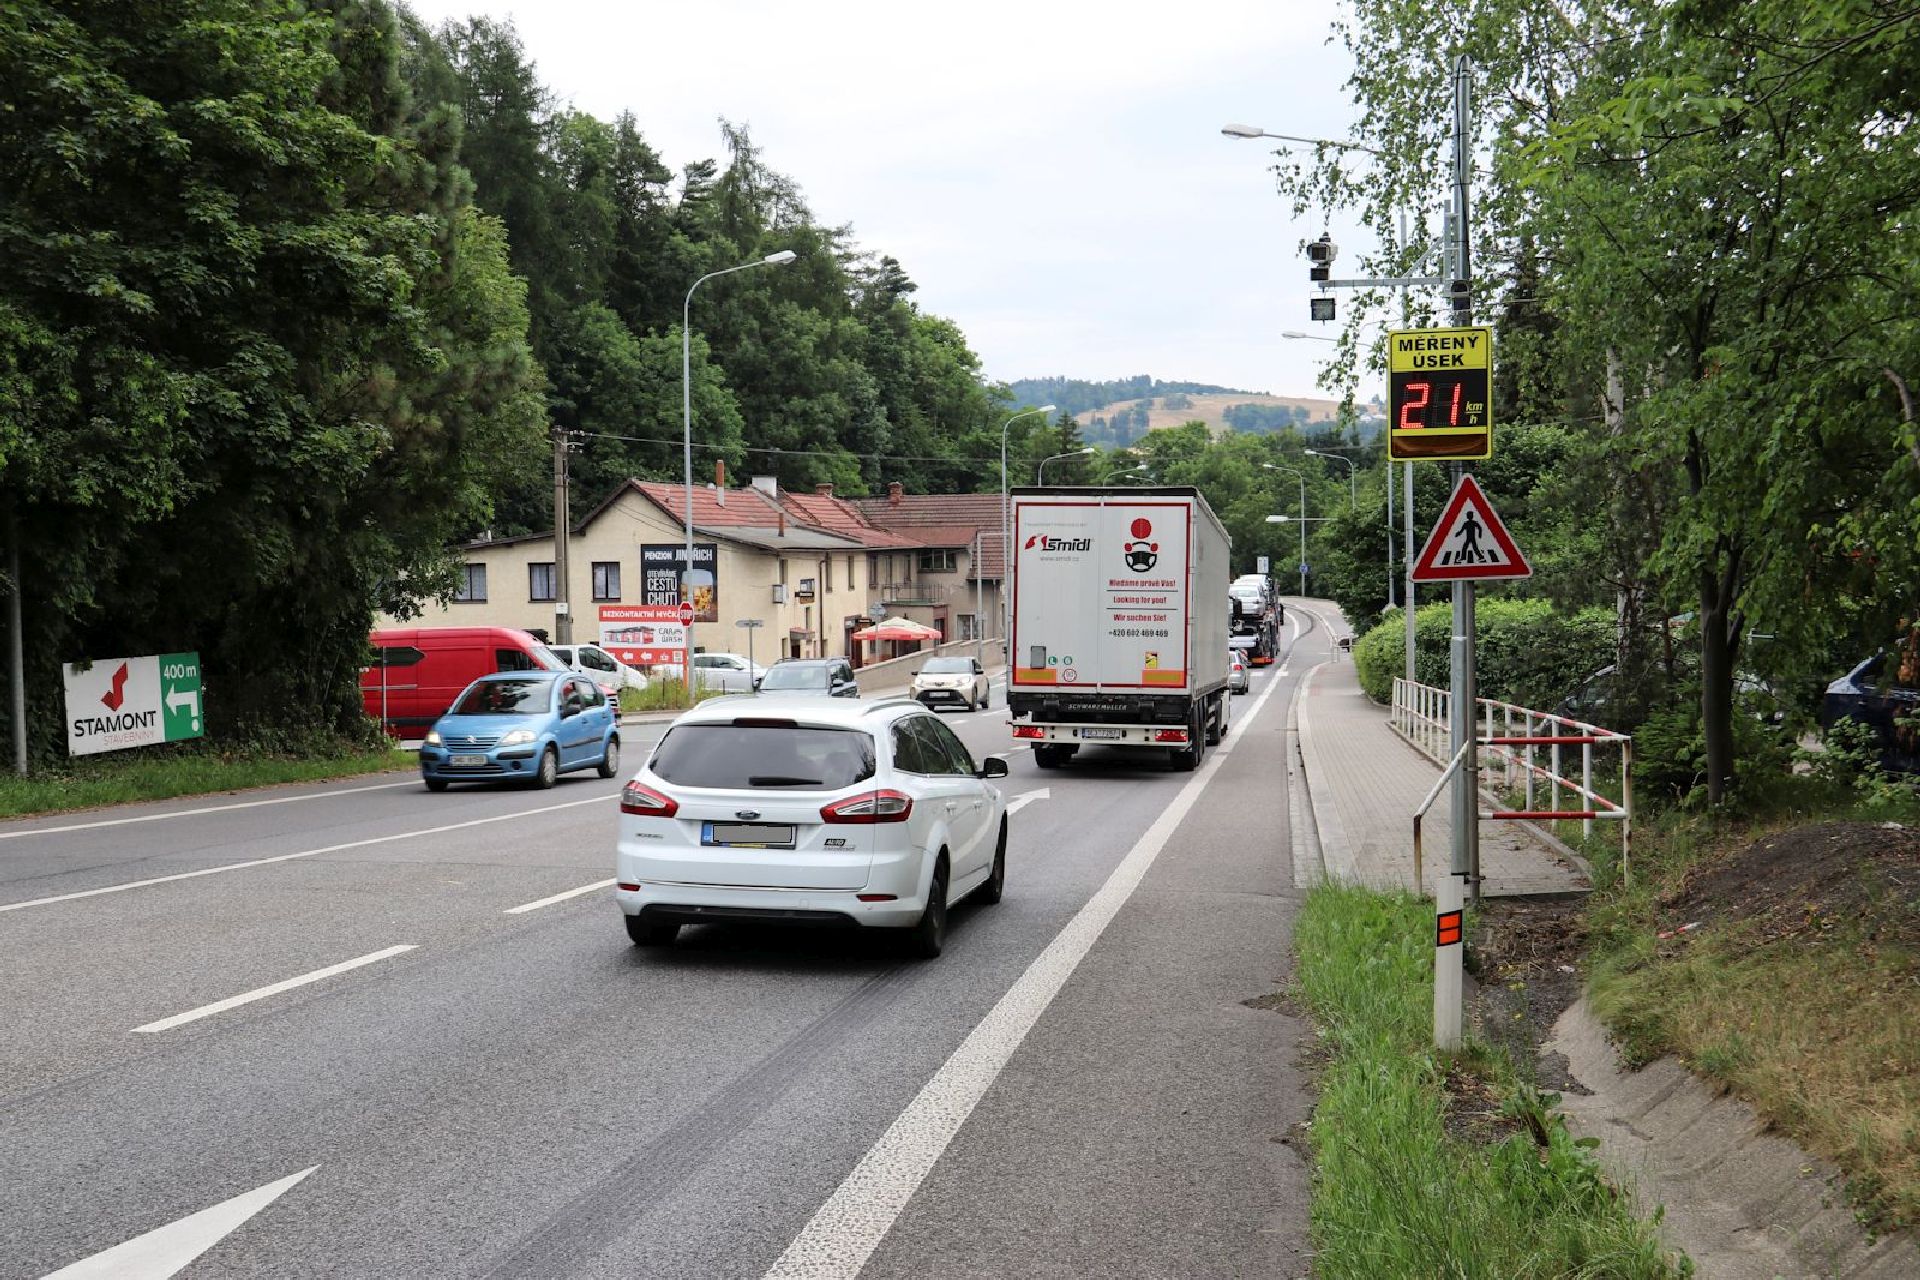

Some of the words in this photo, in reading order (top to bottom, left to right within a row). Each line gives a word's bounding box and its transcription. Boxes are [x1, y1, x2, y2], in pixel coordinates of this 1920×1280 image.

[1399, 333, 1479, 351] MĚŘENÝ
[1413, 352, 1464, 368] ÚSEK
[1400, 382, 1461, 429] 21
[1465, 401, 1483, 411] km
[1469, 415, 1477, 424] h
[675, 547, 713, 561] JINŘICH
[647, 578, 678, 591] CESTU
[680, 609, 692, 620] STOP
[164, 664, 184, 680] 400
[185, 665, 196, 677] m
[74, 711, 157, 737] STAMONT
